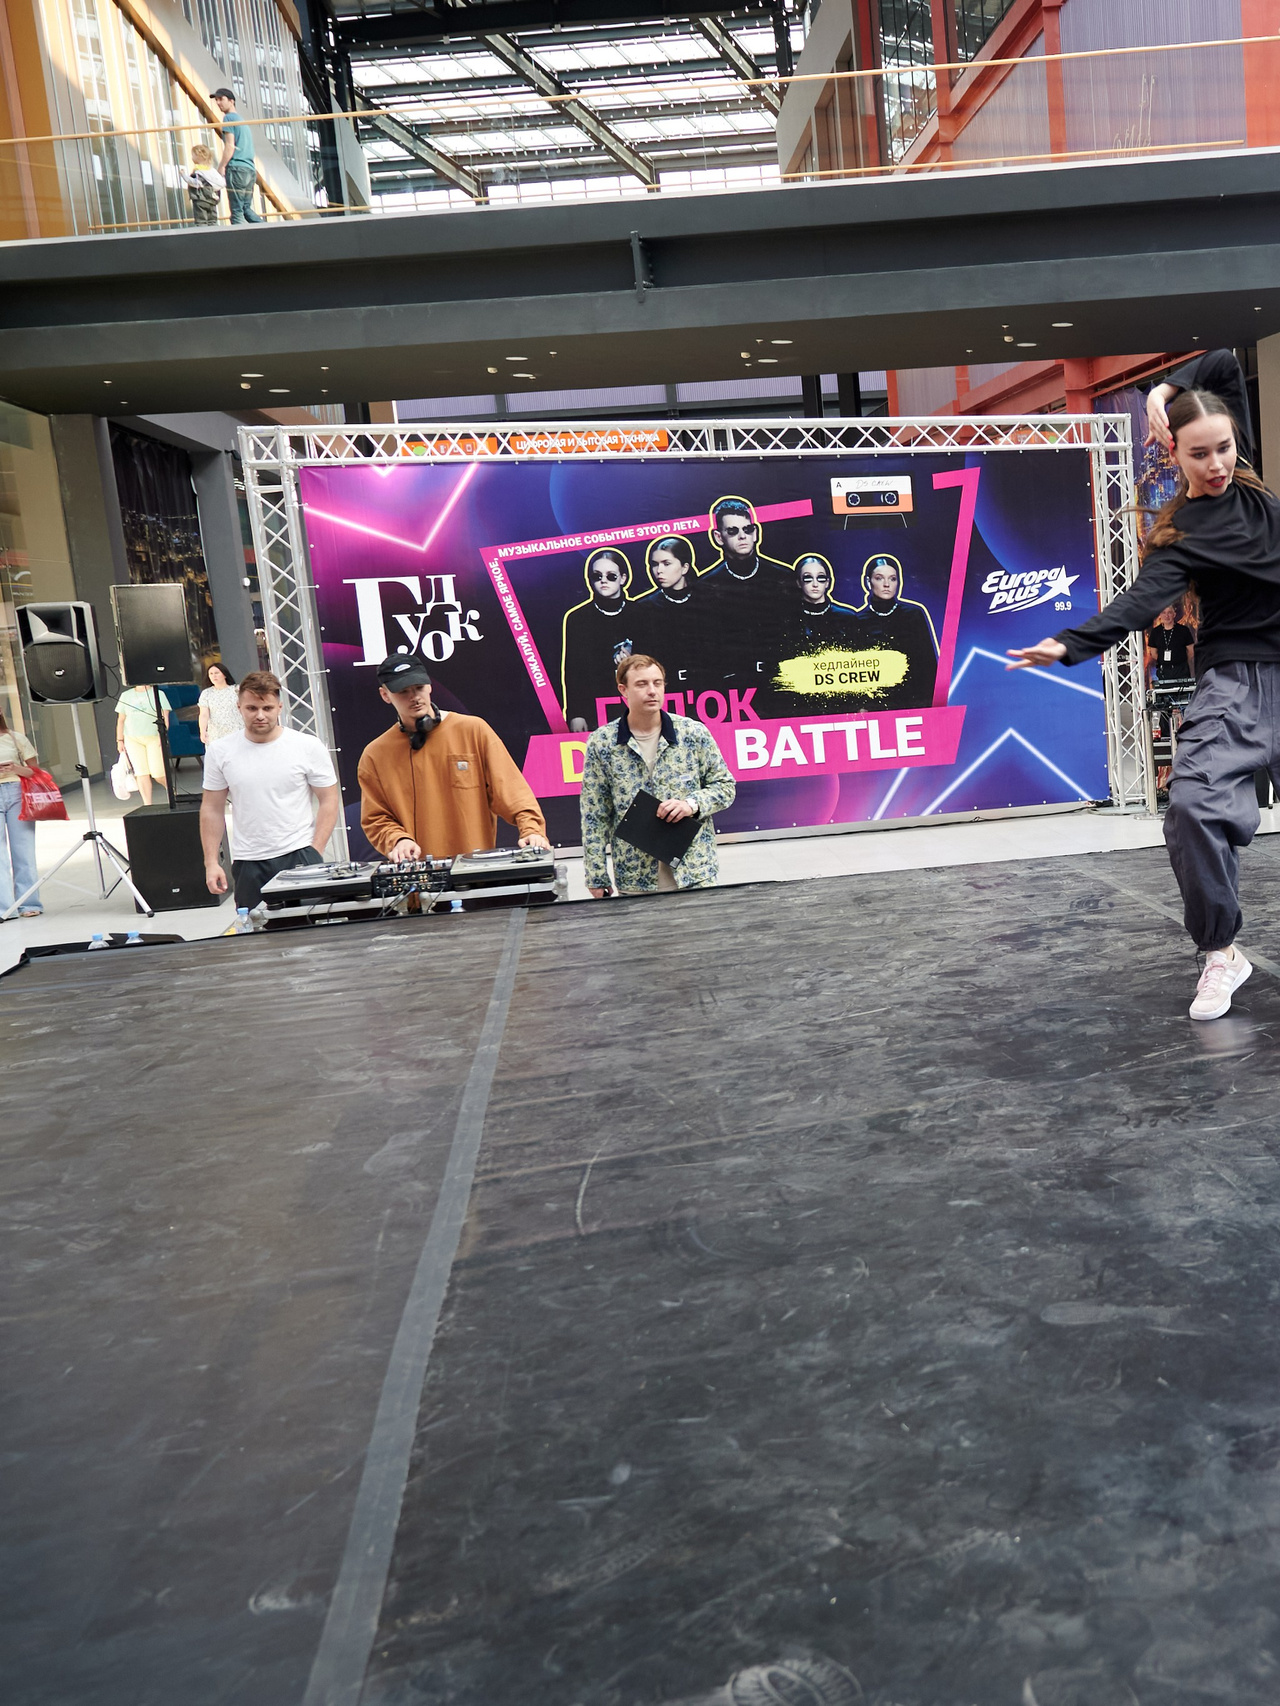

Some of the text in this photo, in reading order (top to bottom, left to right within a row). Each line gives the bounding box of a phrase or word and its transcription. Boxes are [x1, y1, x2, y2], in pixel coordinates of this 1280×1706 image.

[498, 519, 700, 557] МУЗЫКАЛЬНОЕ СОБЫТИЕ ЭТОГО ЛЕТА
[981, 567, 1062, 594] Europa
[1054, 601, 1072, 611] 99.9
[488, 557, 546, 687] ПОЖАЛУЙ, САМОЕ ЯРКОЕ,
[813, 656, 880, 672] хедлайнер
[814, 670, 881, 685] DS CREW
[734, 716, 926, 770] BATTLE
